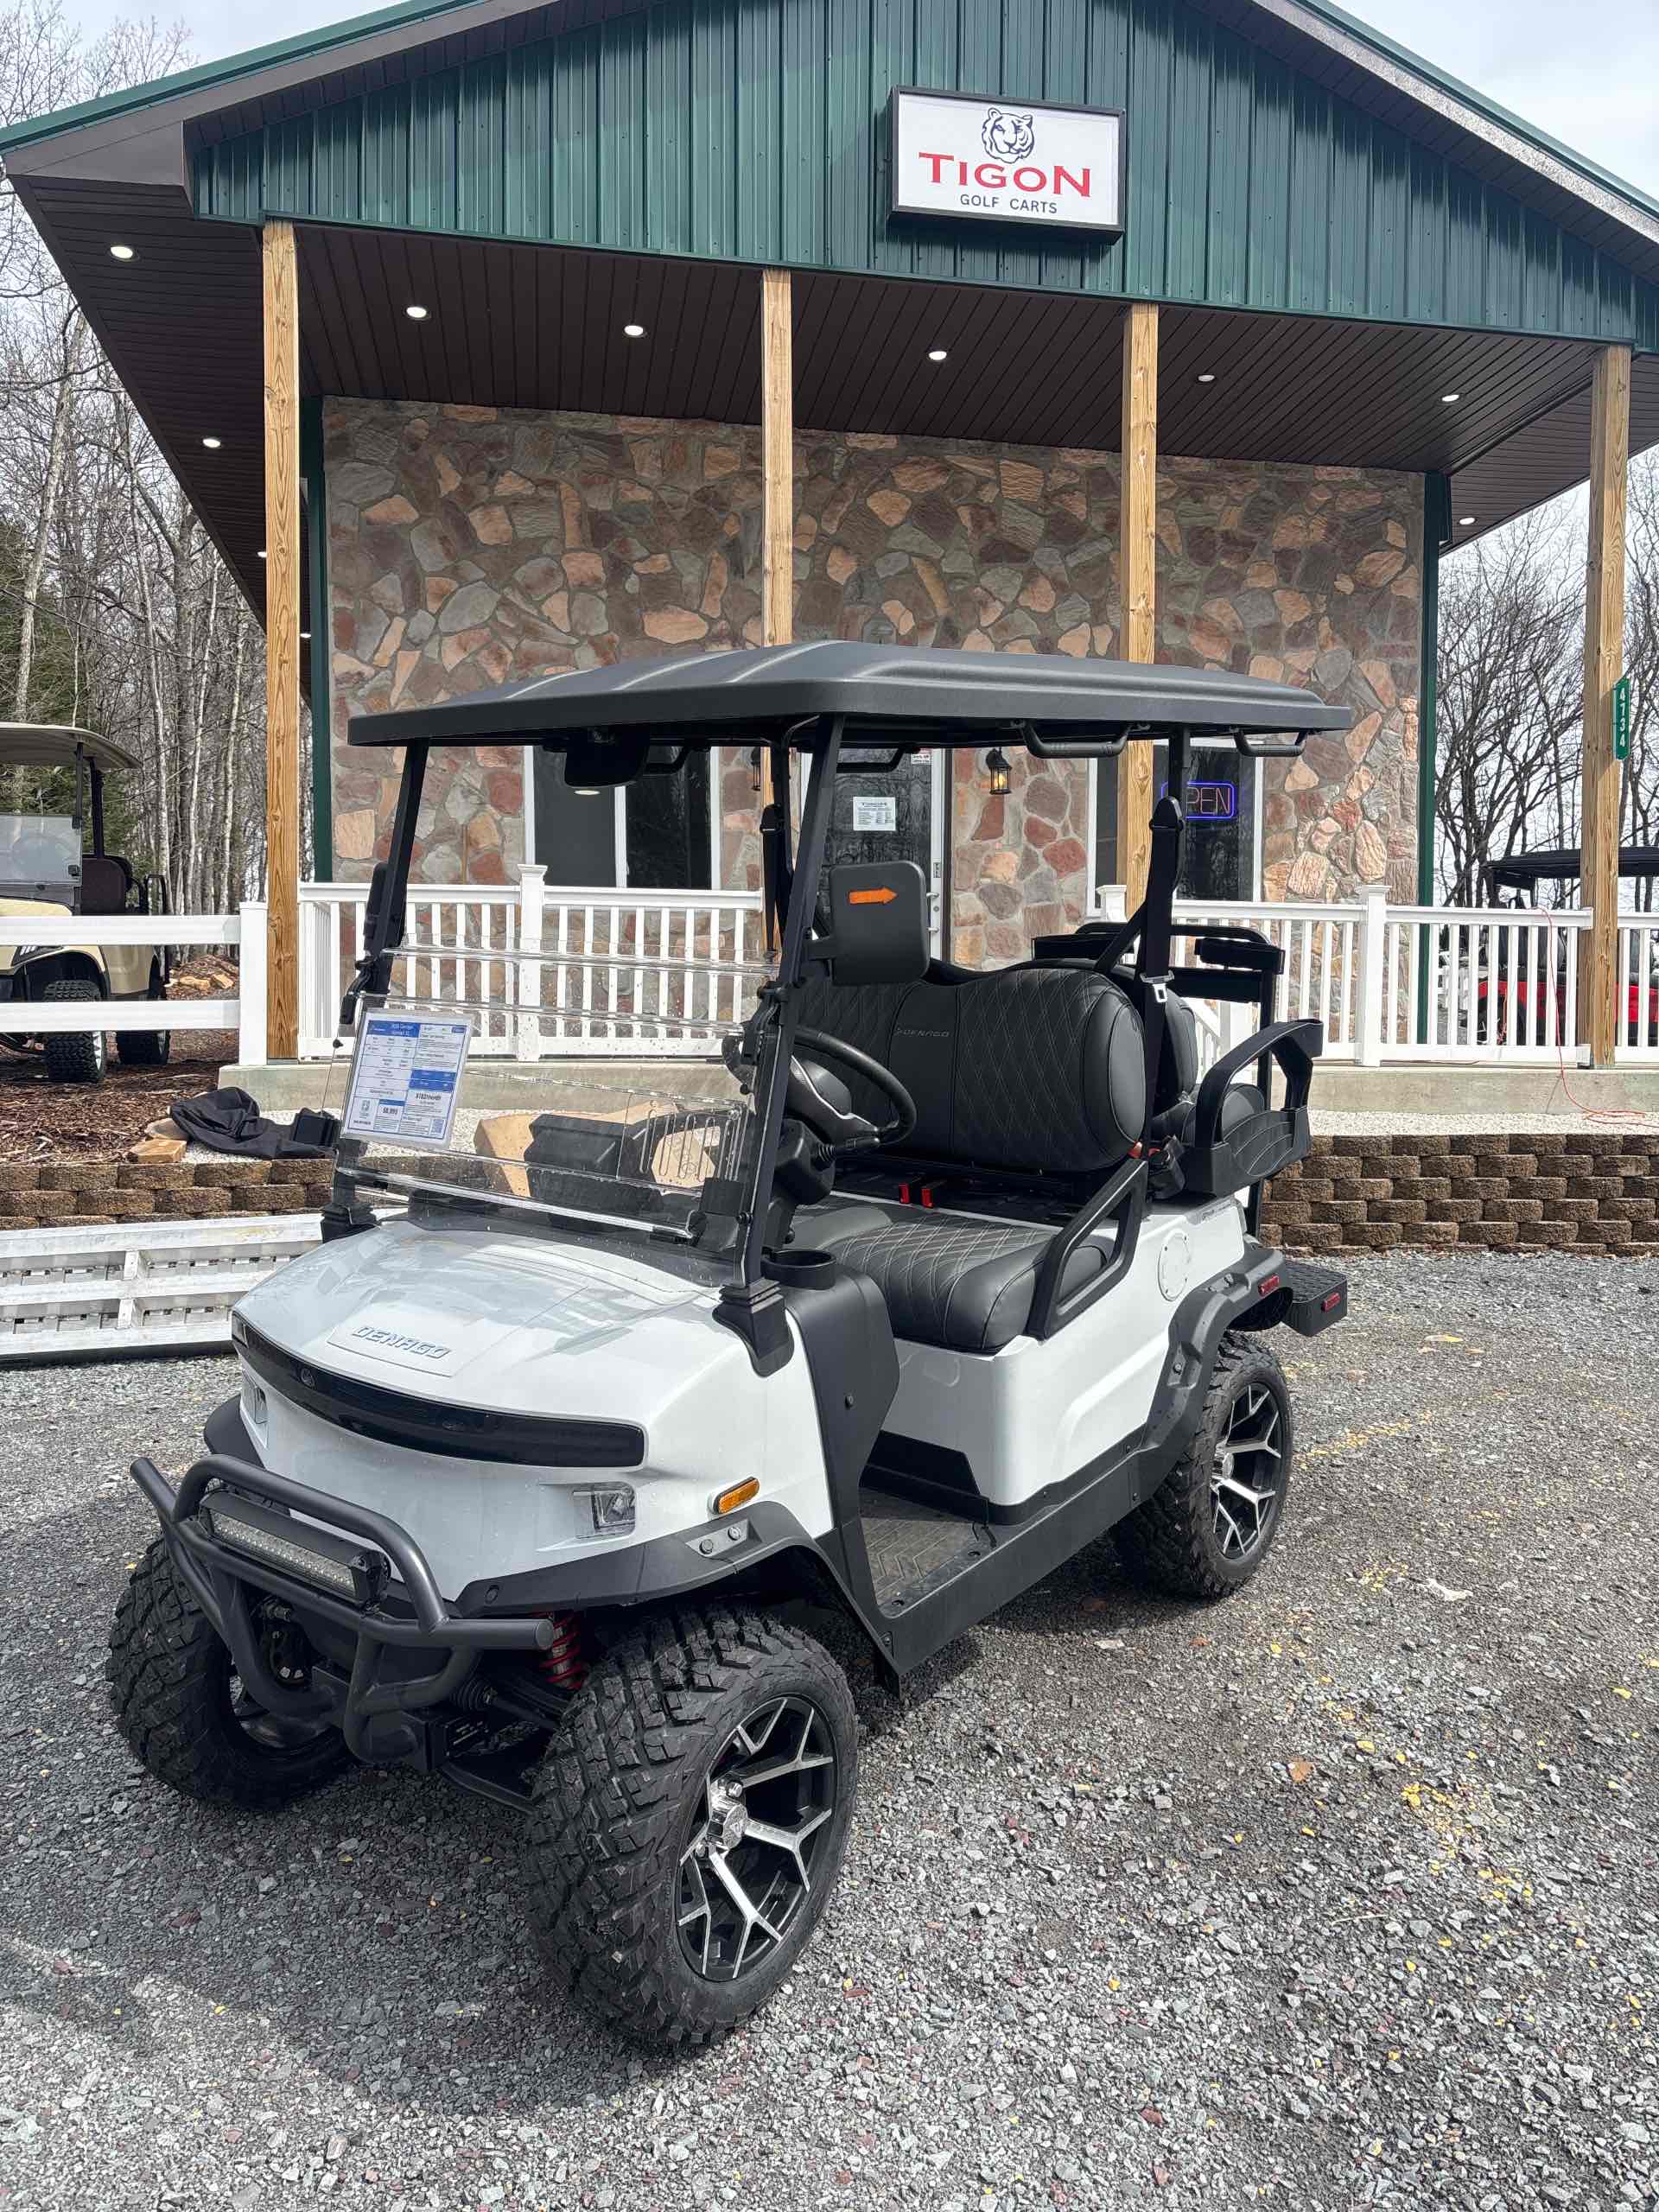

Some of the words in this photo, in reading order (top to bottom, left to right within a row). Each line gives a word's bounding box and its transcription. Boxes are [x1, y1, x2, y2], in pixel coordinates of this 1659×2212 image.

[918, 151, 1091, 198] TIGON
[960, 193, 1000, 209] GOLF
[1009, 198, 1058, 214] CARTS
[1185, 786, 1231, 815] PEN
[352, 1325, 452, 1359] DENAGO
